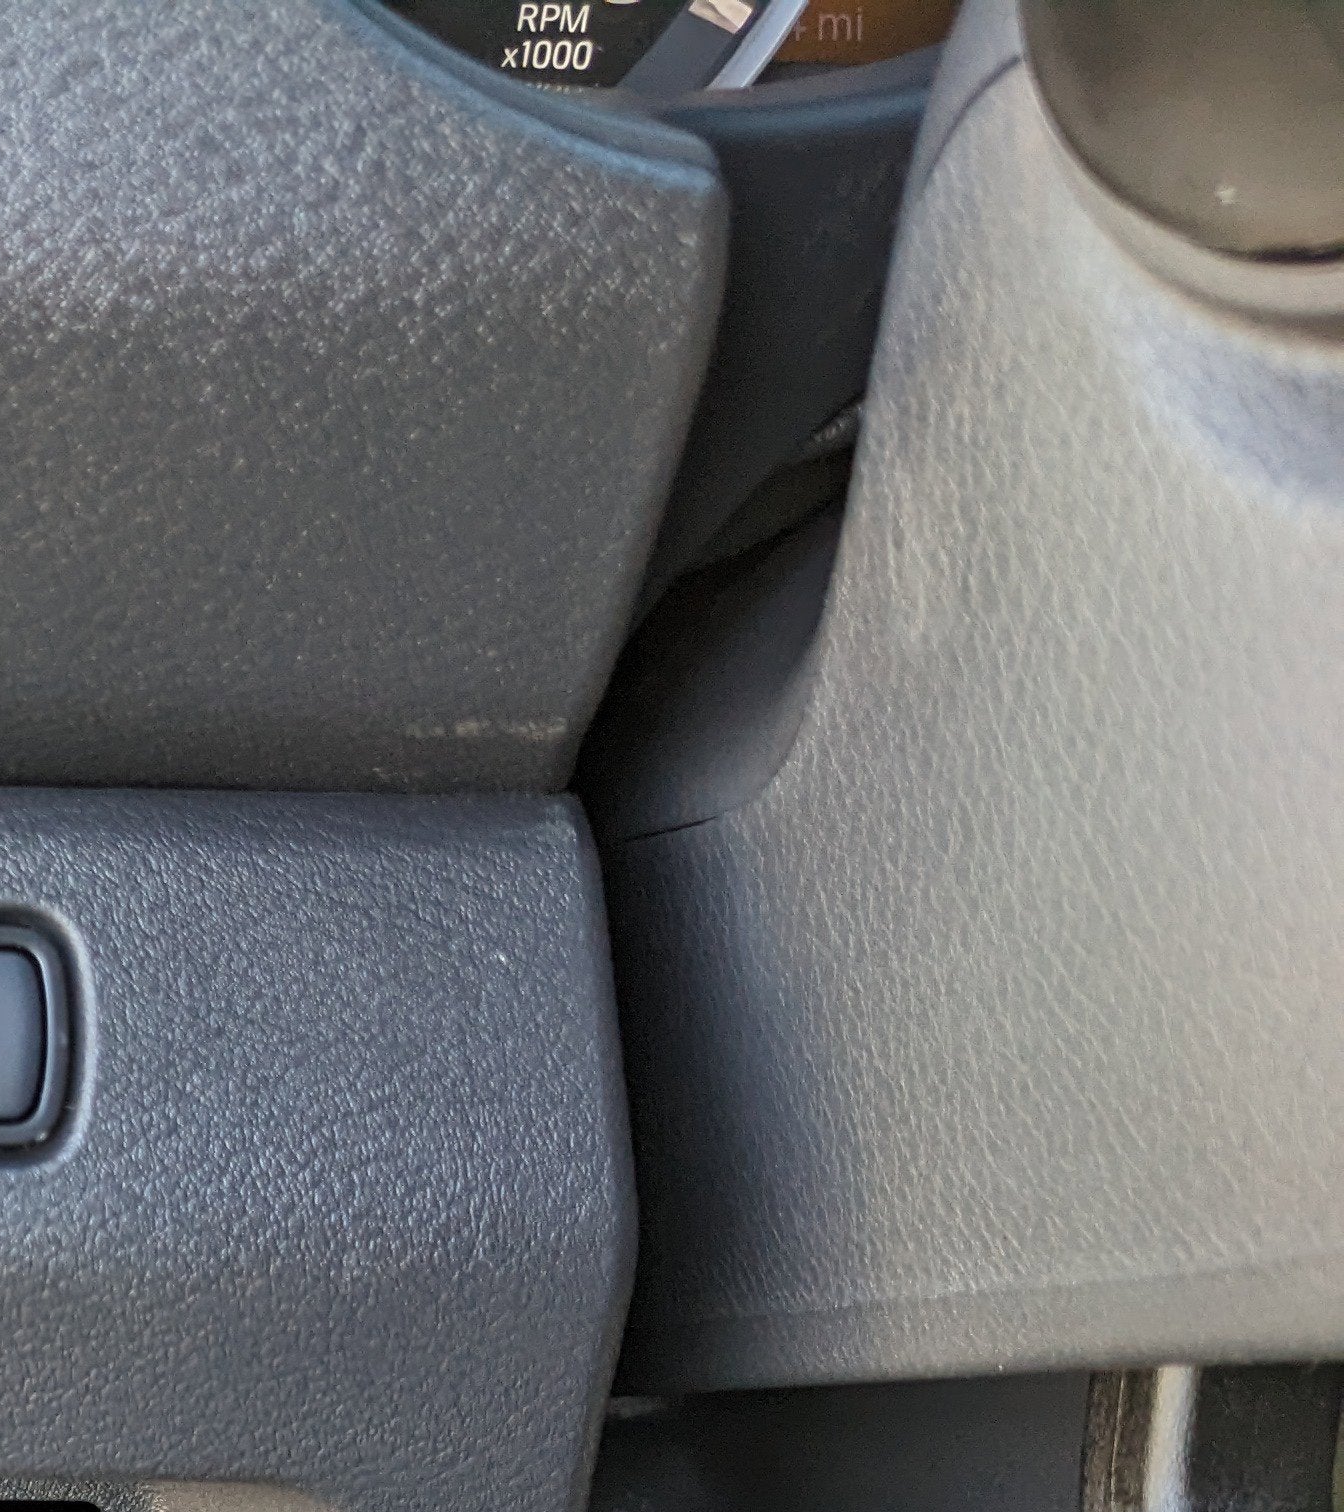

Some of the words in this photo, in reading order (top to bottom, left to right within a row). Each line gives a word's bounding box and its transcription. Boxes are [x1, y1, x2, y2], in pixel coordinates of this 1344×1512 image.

[516, 3, 591, 33] RPM
[818, 6, 863, 41] mi
[500, 39, 593, 71] x1000
